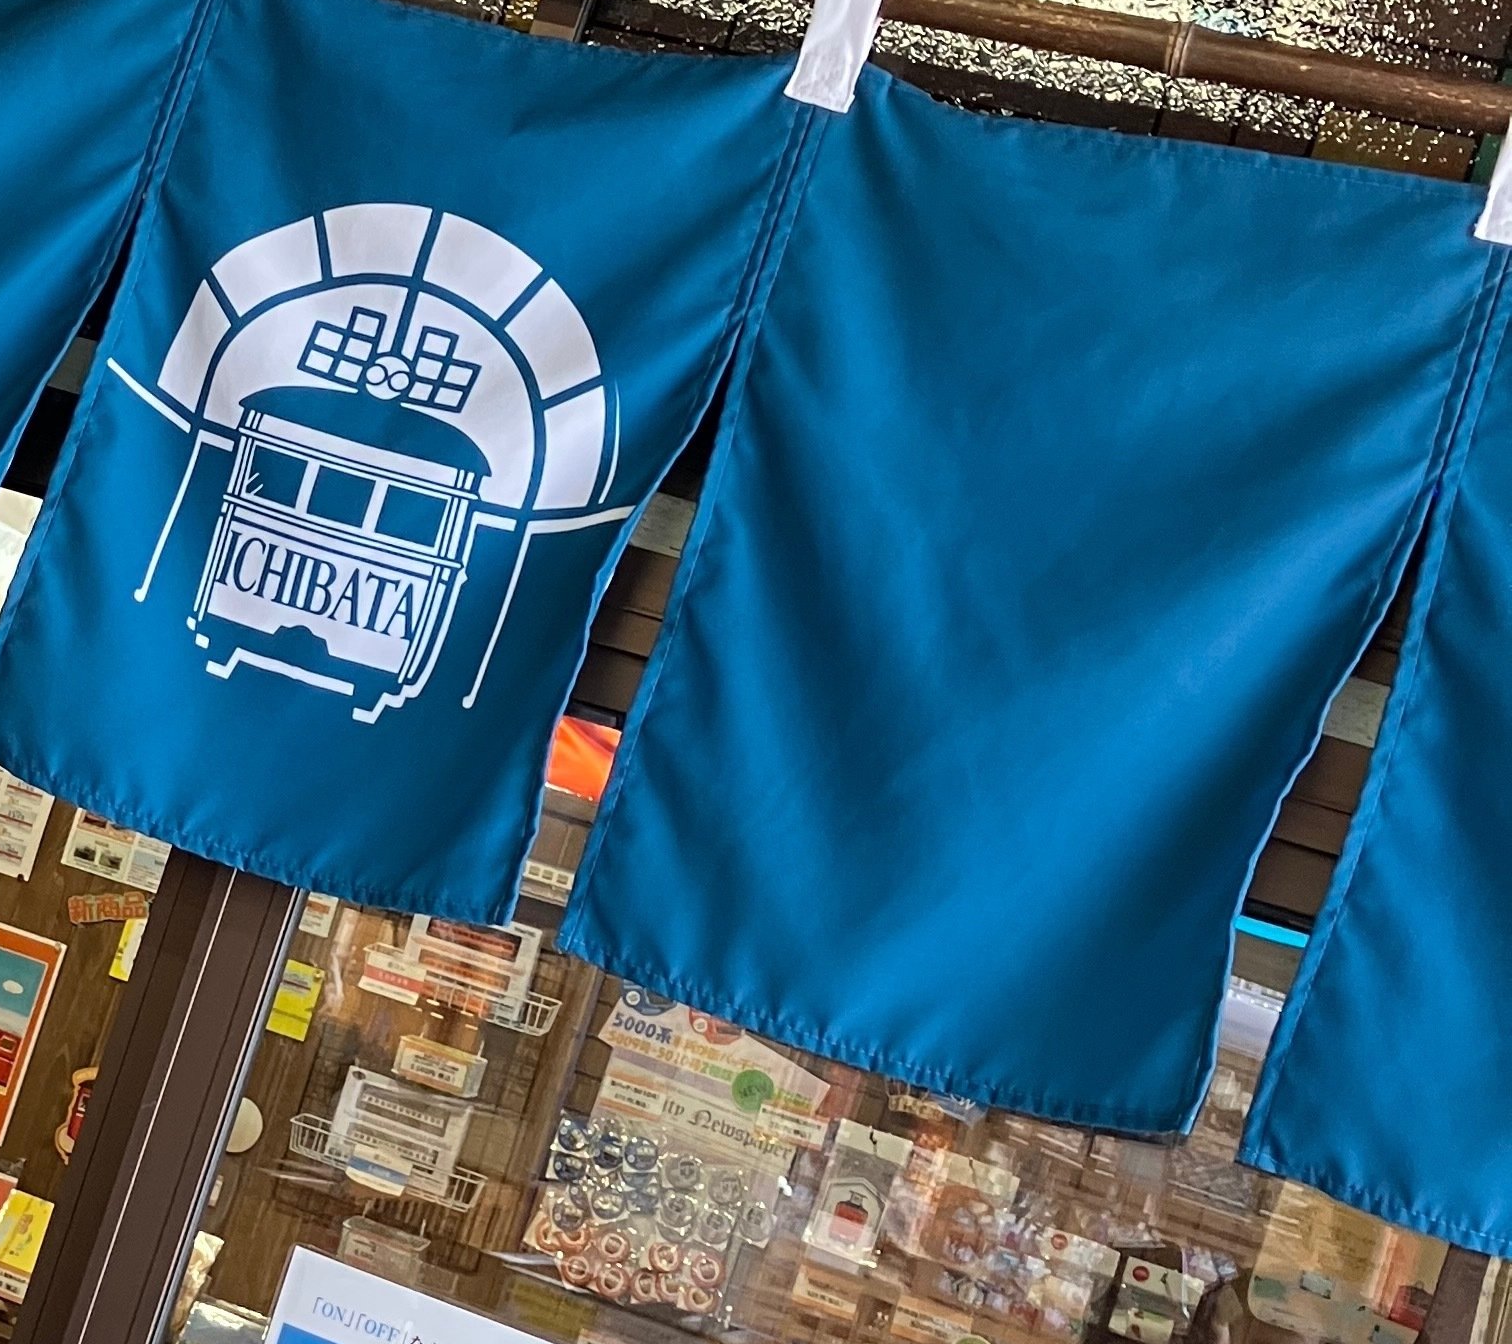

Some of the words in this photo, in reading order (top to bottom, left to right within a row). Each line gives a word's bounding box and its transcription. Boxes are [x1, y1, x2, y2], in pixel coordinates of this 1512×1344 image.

[215, 529, 414, 640] ICHIBATA
[70, 896, 146, 921] 新商品
[612, 1012, 673, 1045] 5000系
